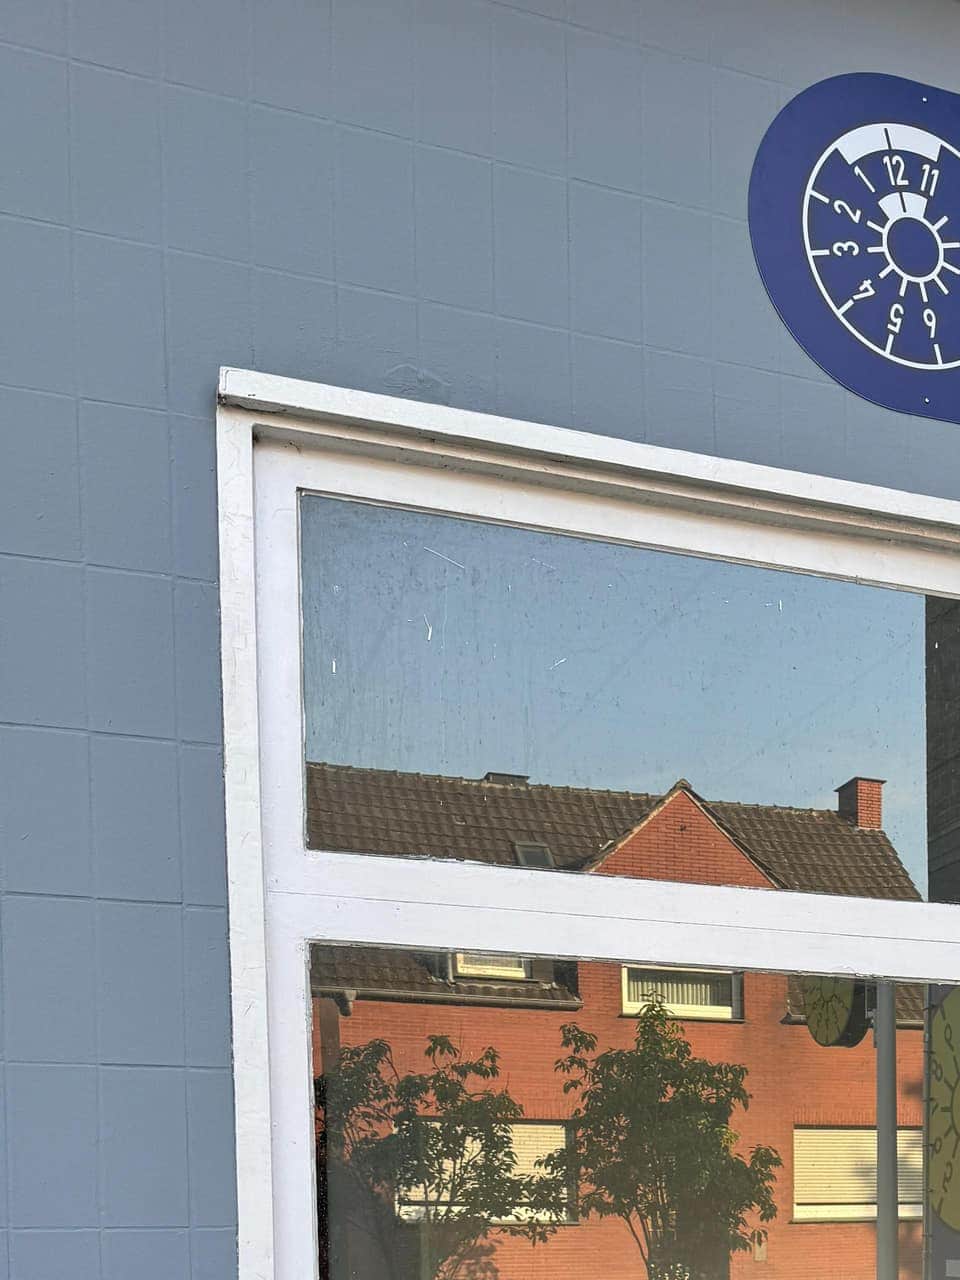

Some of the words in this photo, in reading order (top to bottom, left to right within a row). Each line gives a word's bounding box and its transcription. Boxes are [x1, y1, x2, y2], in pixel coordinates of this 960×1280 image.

[854, 166, 875, 192] 1
[883, 156, 909, 186] 12
[921, 164, 939, 196] 11
[833, 200, 861, 223] 2
[833, 241, 859, 256] 3
[853, 280, 875, 300] 4
[887, 303, 904, 333] 5
[923, 308, 936, 338] 6
